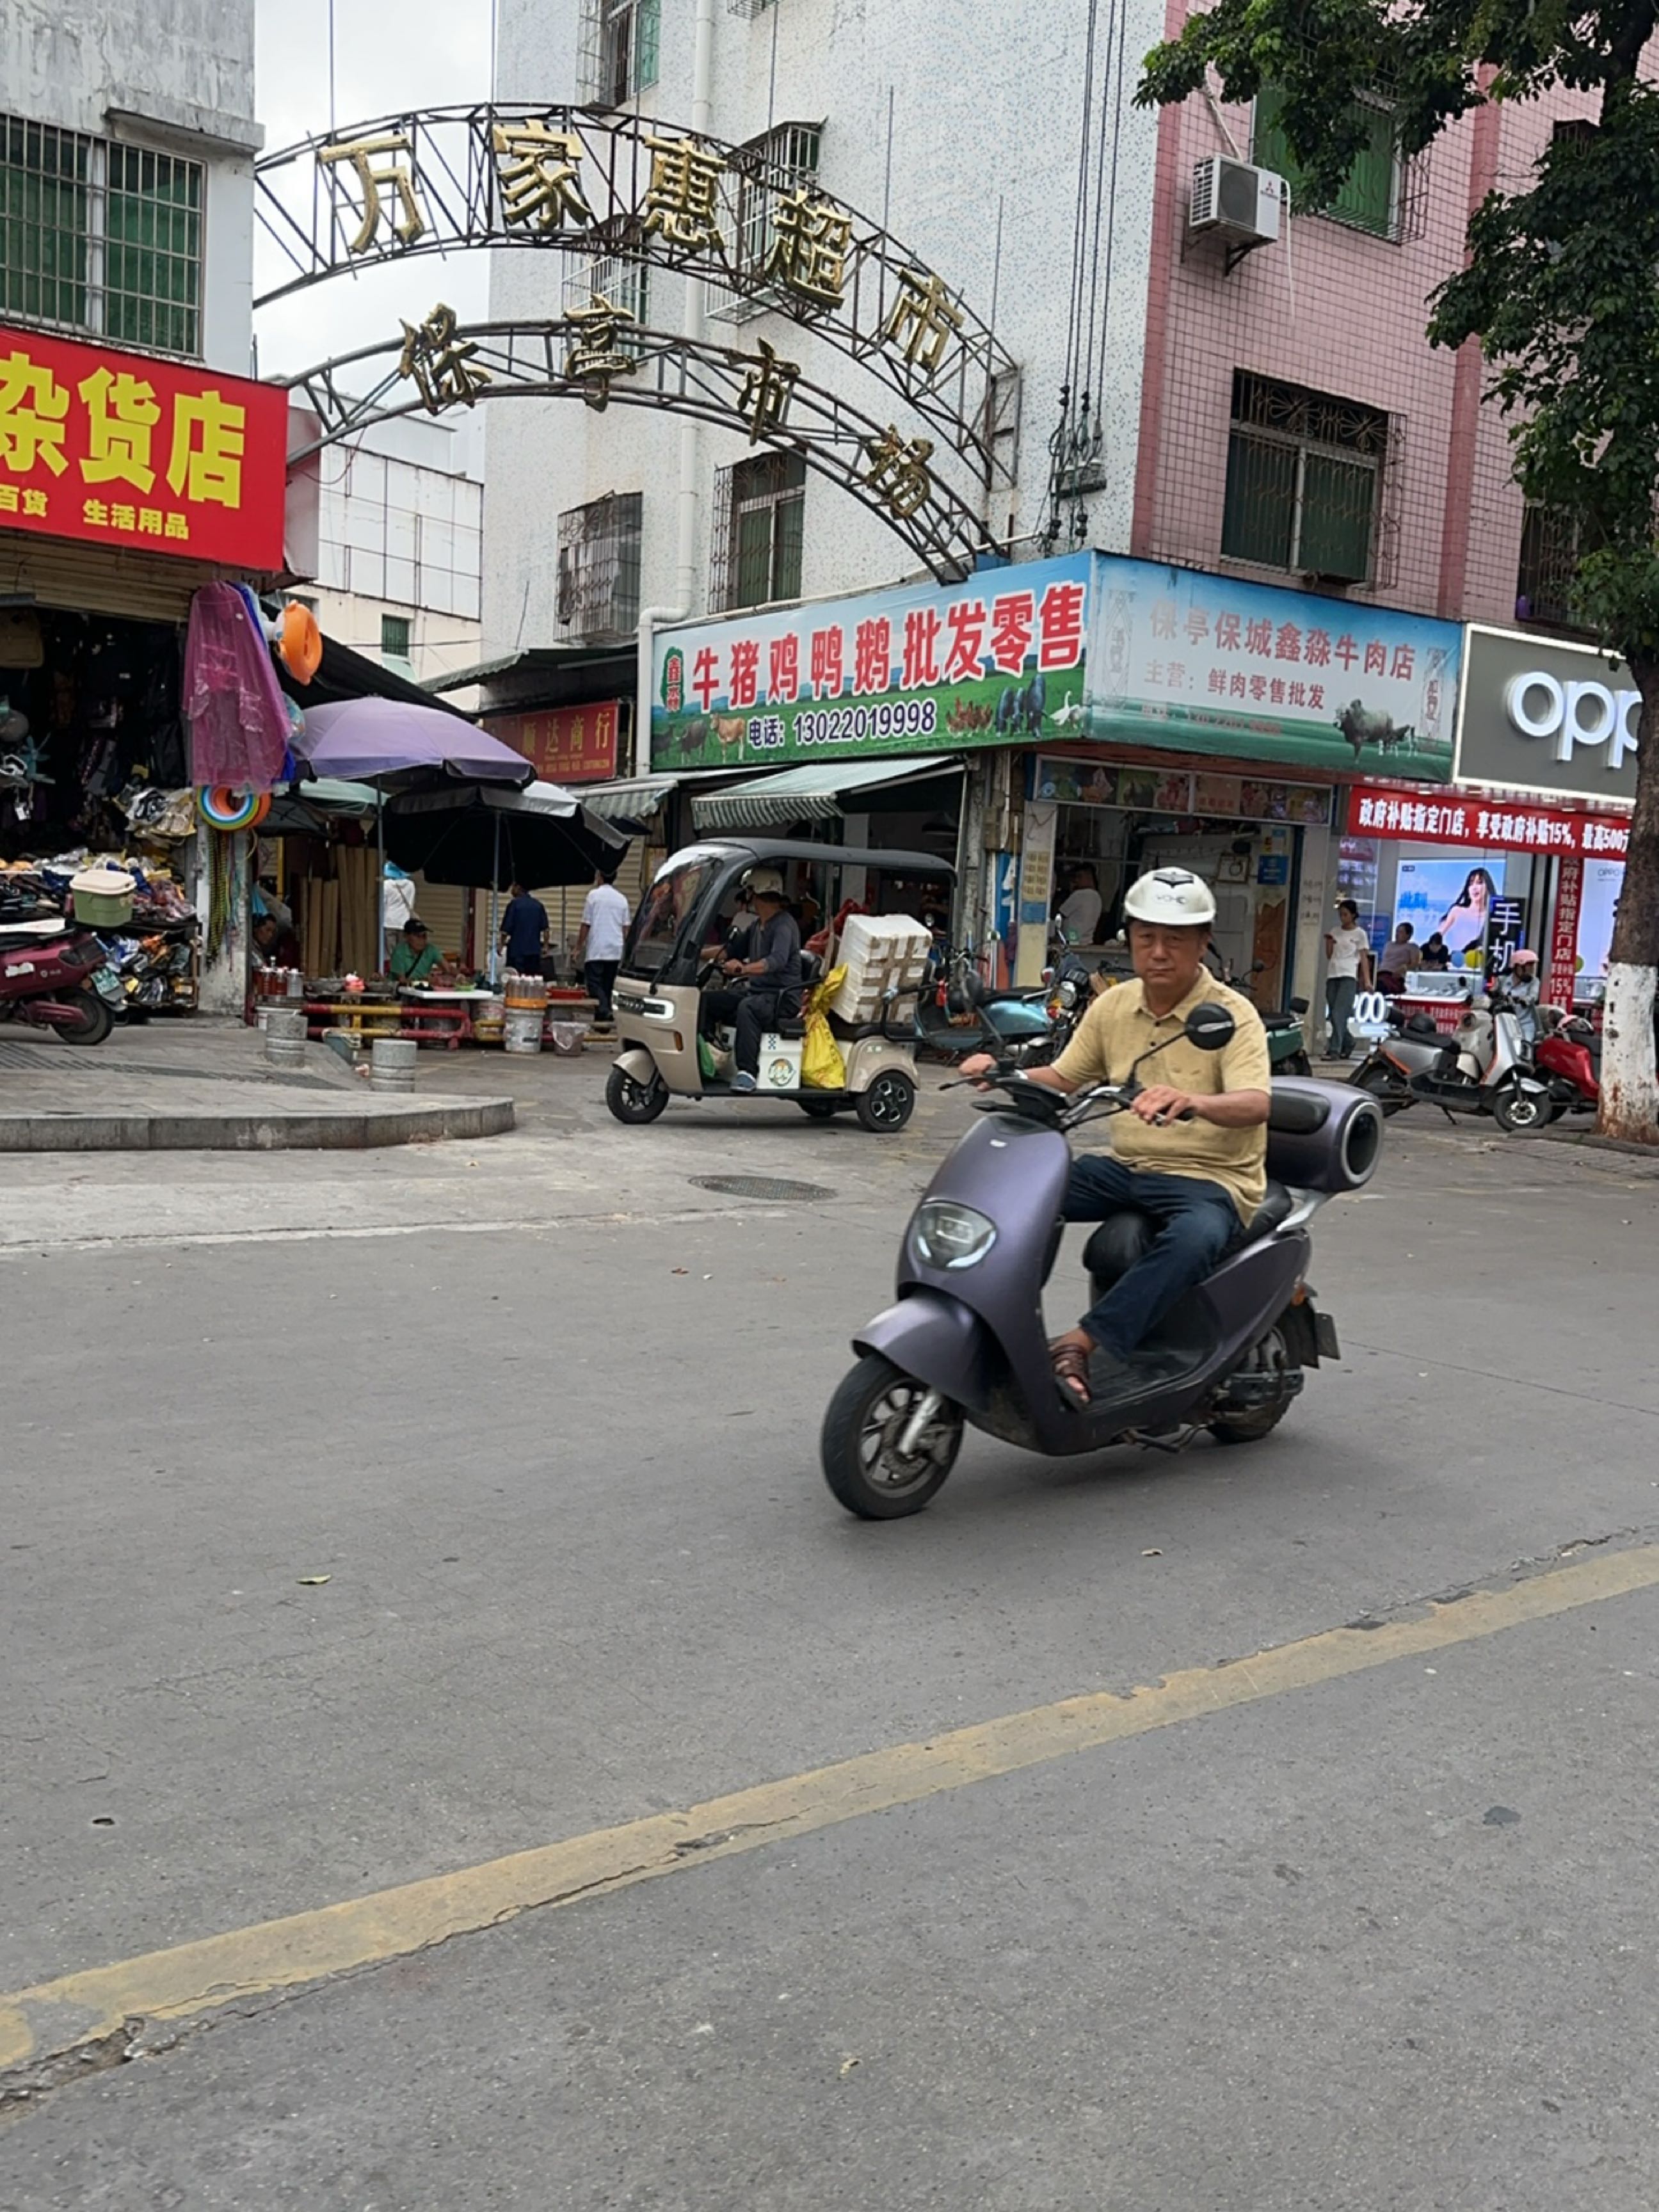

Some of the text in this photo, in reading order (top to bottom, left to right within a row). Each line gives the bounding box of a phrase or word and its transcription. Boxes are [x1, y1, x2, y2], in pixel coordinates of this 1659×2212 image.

[316, 119, 965, 373] 万家惠超市
[0, 351, 245, 508] 杂货店
[0, 484, 189, 540] 百货 生活用品
[693, 581, 1085, 712] 牛猪鸡鸭鹅批发零售
[1150, 598, 1416, 680] 保亭保城鑫淼牛肉店
[794, 700, 936, 744] 13022019998
[1490, 902, 1522, 972] 手机
